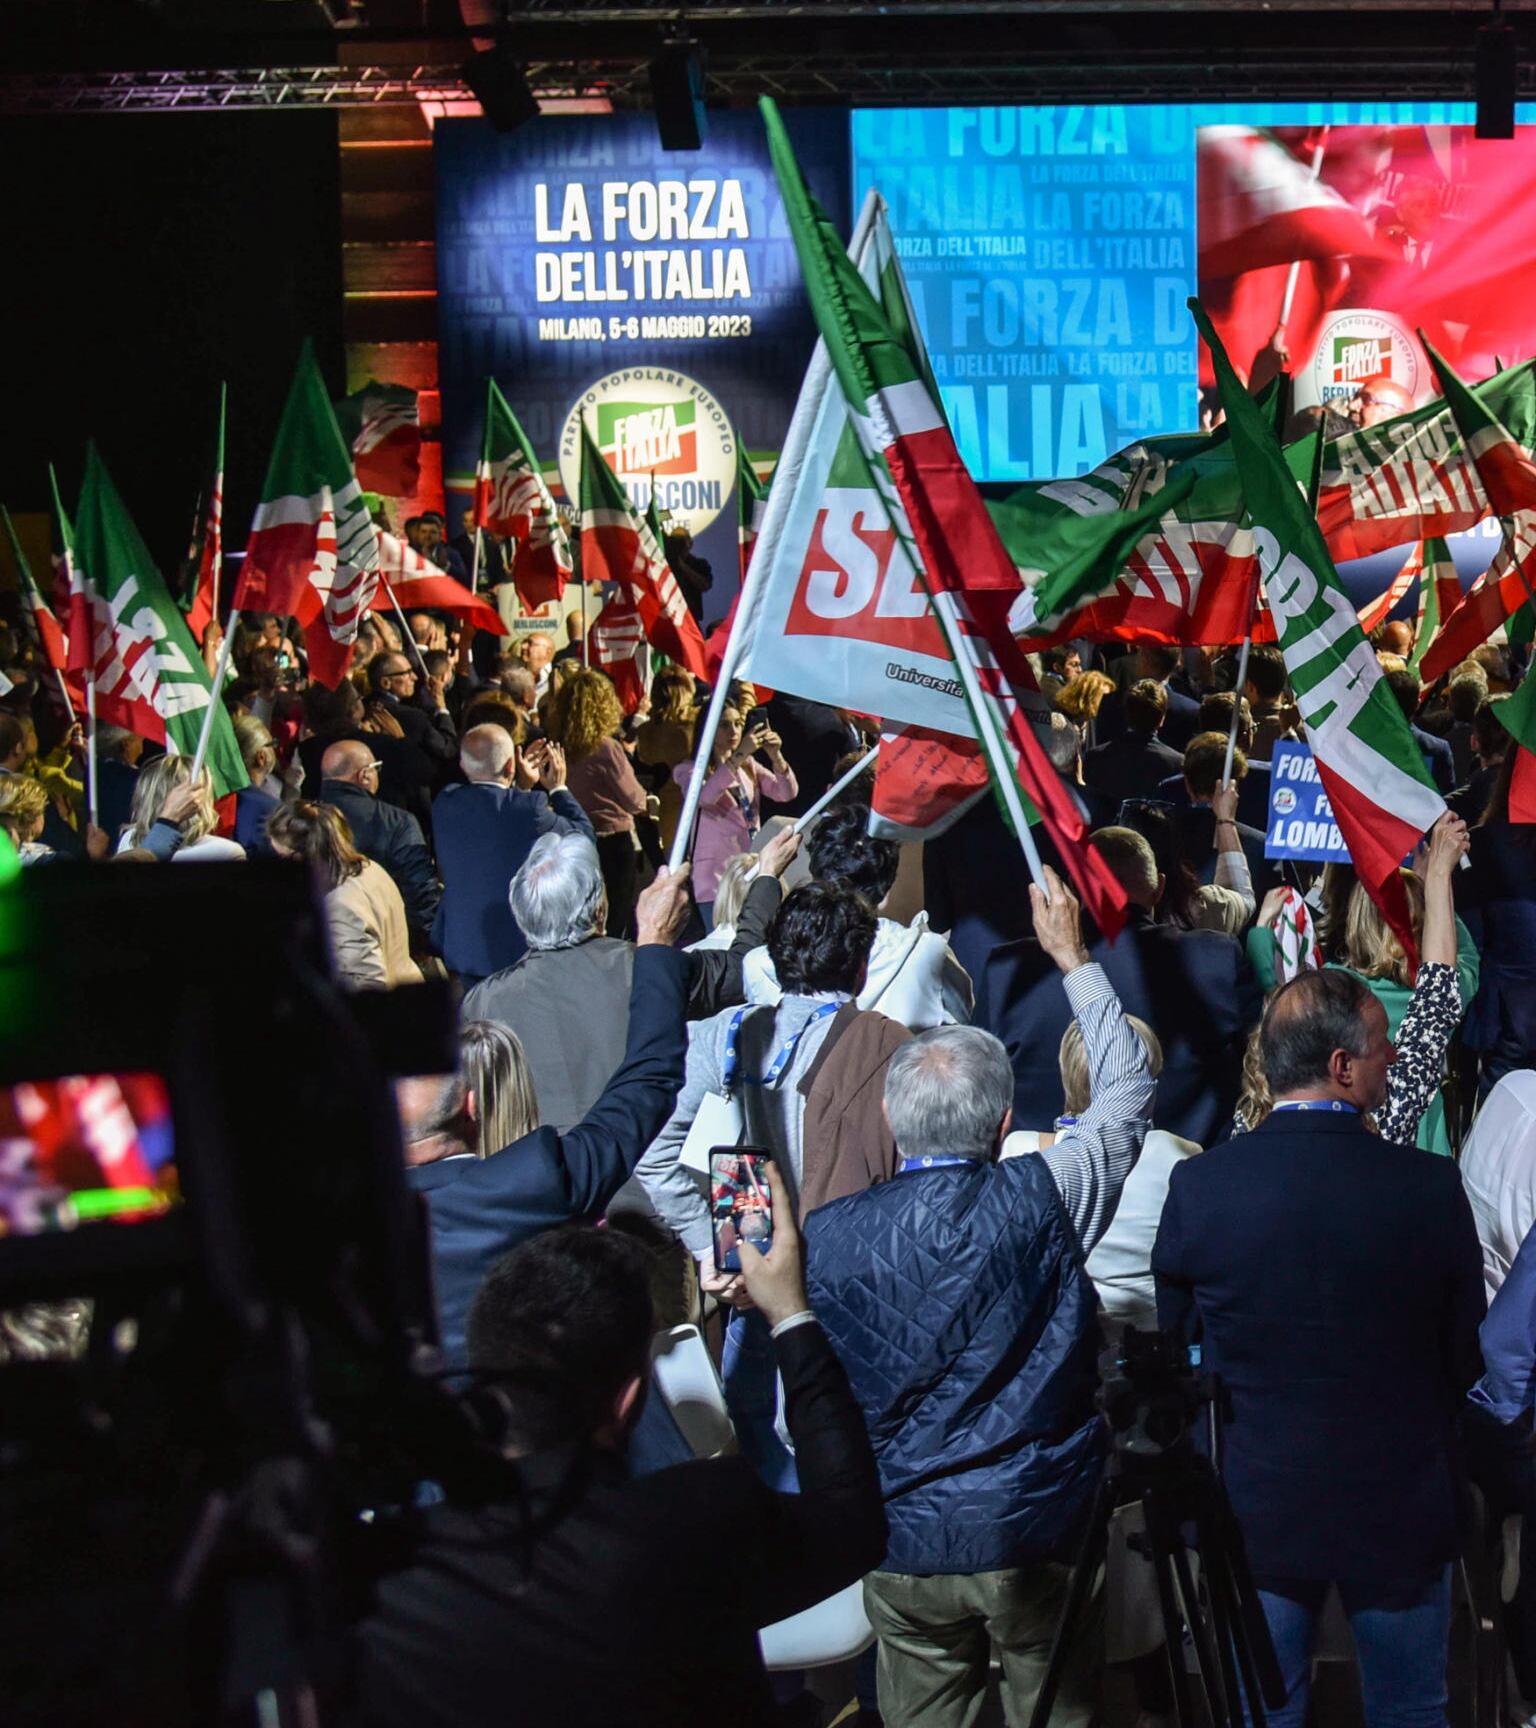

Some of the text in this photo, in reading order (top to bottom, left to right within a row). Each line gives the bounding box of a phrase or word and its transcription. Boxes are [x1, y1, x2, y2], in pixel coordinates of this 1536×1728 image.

[535, 183, 592, 242] LA
[602, 180, 750, 241] FORZA
[1033, 191, 1184, 231] LA FORZA
[893, 236, 1027, 257] ORZA DELL'ITALIA
[1033, 237, 1185, 270] DELL'ITALIA
[535, 249, 751, 302] DELL'ITALIA
[538, 315, 752, 341] MILANO, 5-6 MAGGIO 2023
[951, 277, 1132, 347] FORZA
[954, 353, 1058, 377] DELL'ITALIA
[1068, 352, 1092, 376] LA
[1100, 352, 1157, 376] FORZA
[1340, 338, 1380, 365] FORZA
[1341, 354, 1383, 382] ITALIA
[600, 369, 685, 393] POPOLARE
[689, 385, 734, 455] EUROPEO
[612, 405, 680, 450] FORZA
[614, 431, 682, 473] ITALIA
